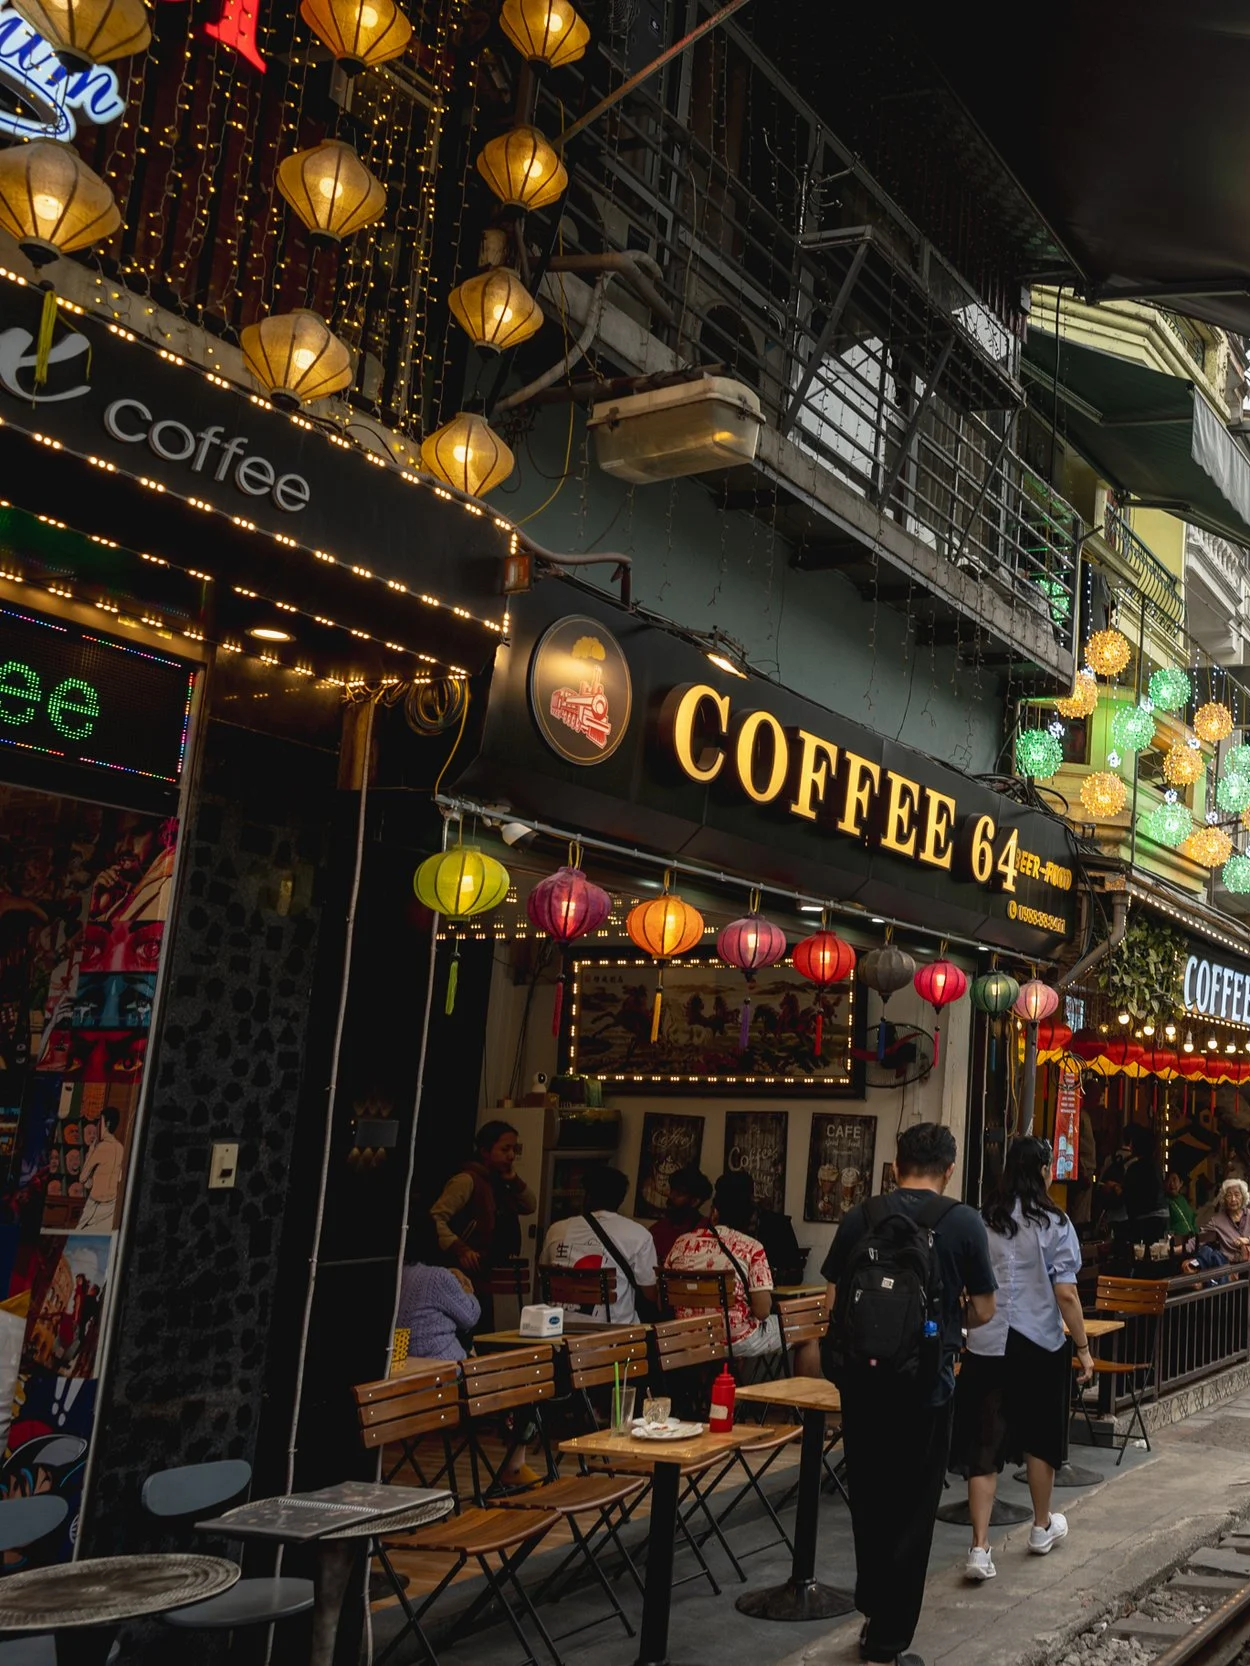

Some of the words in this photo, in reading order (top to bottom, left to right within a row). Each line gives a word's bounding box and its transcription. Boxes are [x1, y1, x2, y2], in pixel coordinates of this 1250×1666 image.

[103, 398, 310, 512] coffee
[670, 683, 957, 871] COFFEE
[970, 814, 1019, 893] 64
[826, 1123, 862, 1139] CAFE
